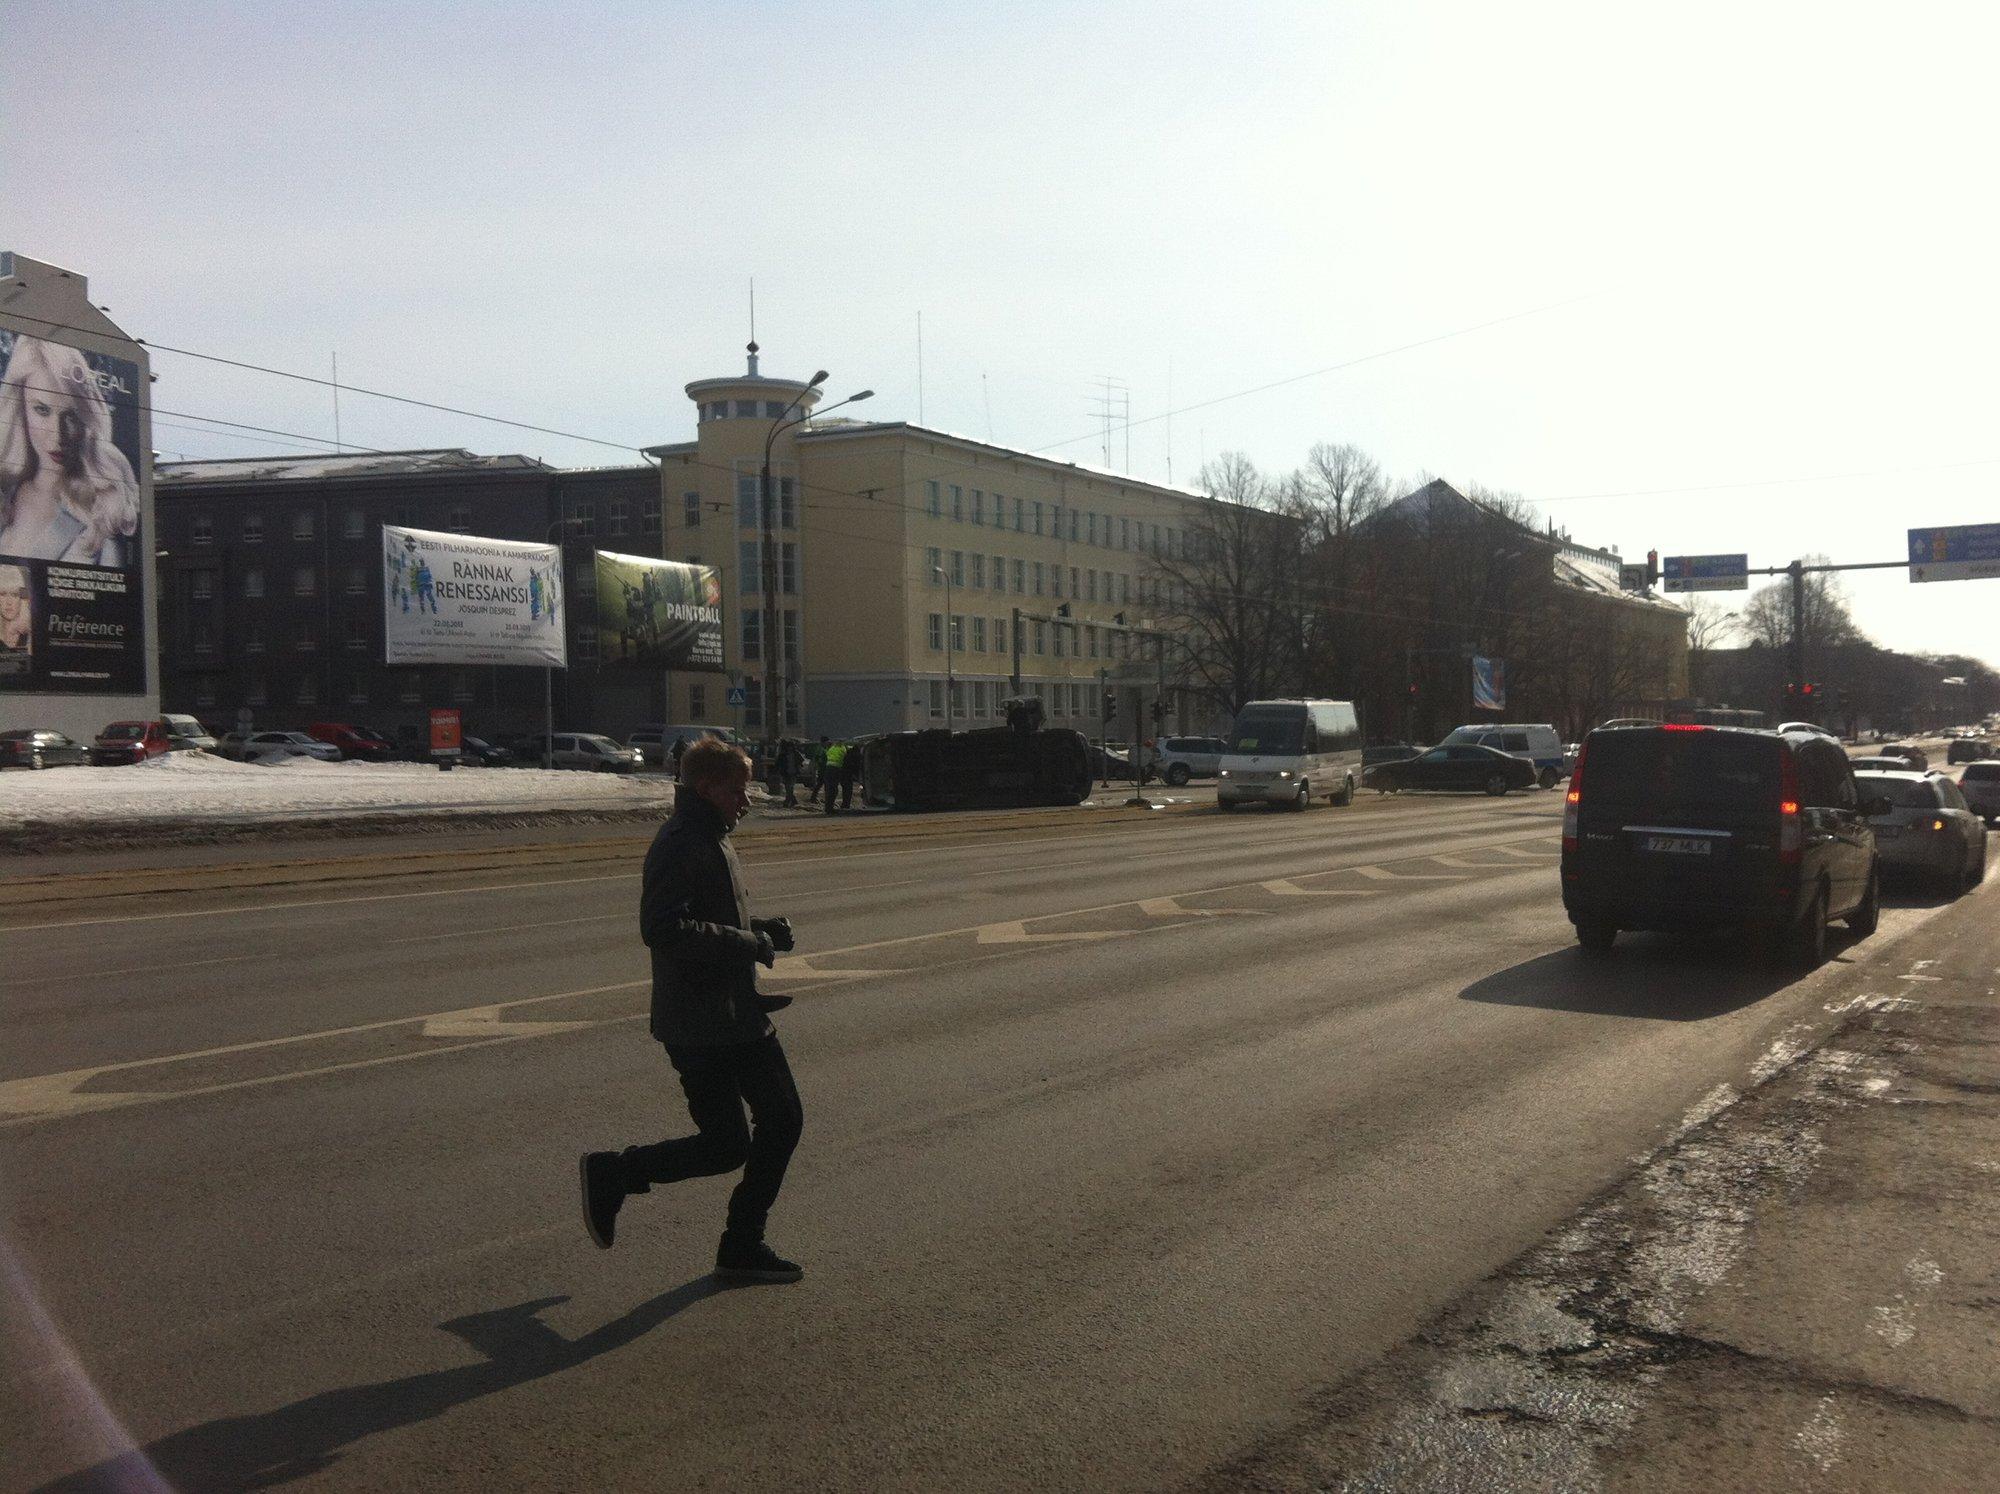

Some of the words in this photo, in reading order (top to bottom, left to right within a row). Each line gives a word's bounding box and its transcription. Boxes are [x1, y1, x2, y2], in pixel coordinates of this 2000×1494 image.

[420, 541, 442, 551] EESTI
[443, 543, 501, 557] FILHARMOONIA
[502, 549, 550, 562] KAMMERKOOR
[435, 580, 529, 604] RENESSANSSI
[458, 605, 488, 615] JOSQUIN
[666, 602, 721, 624] PAINTBALL
